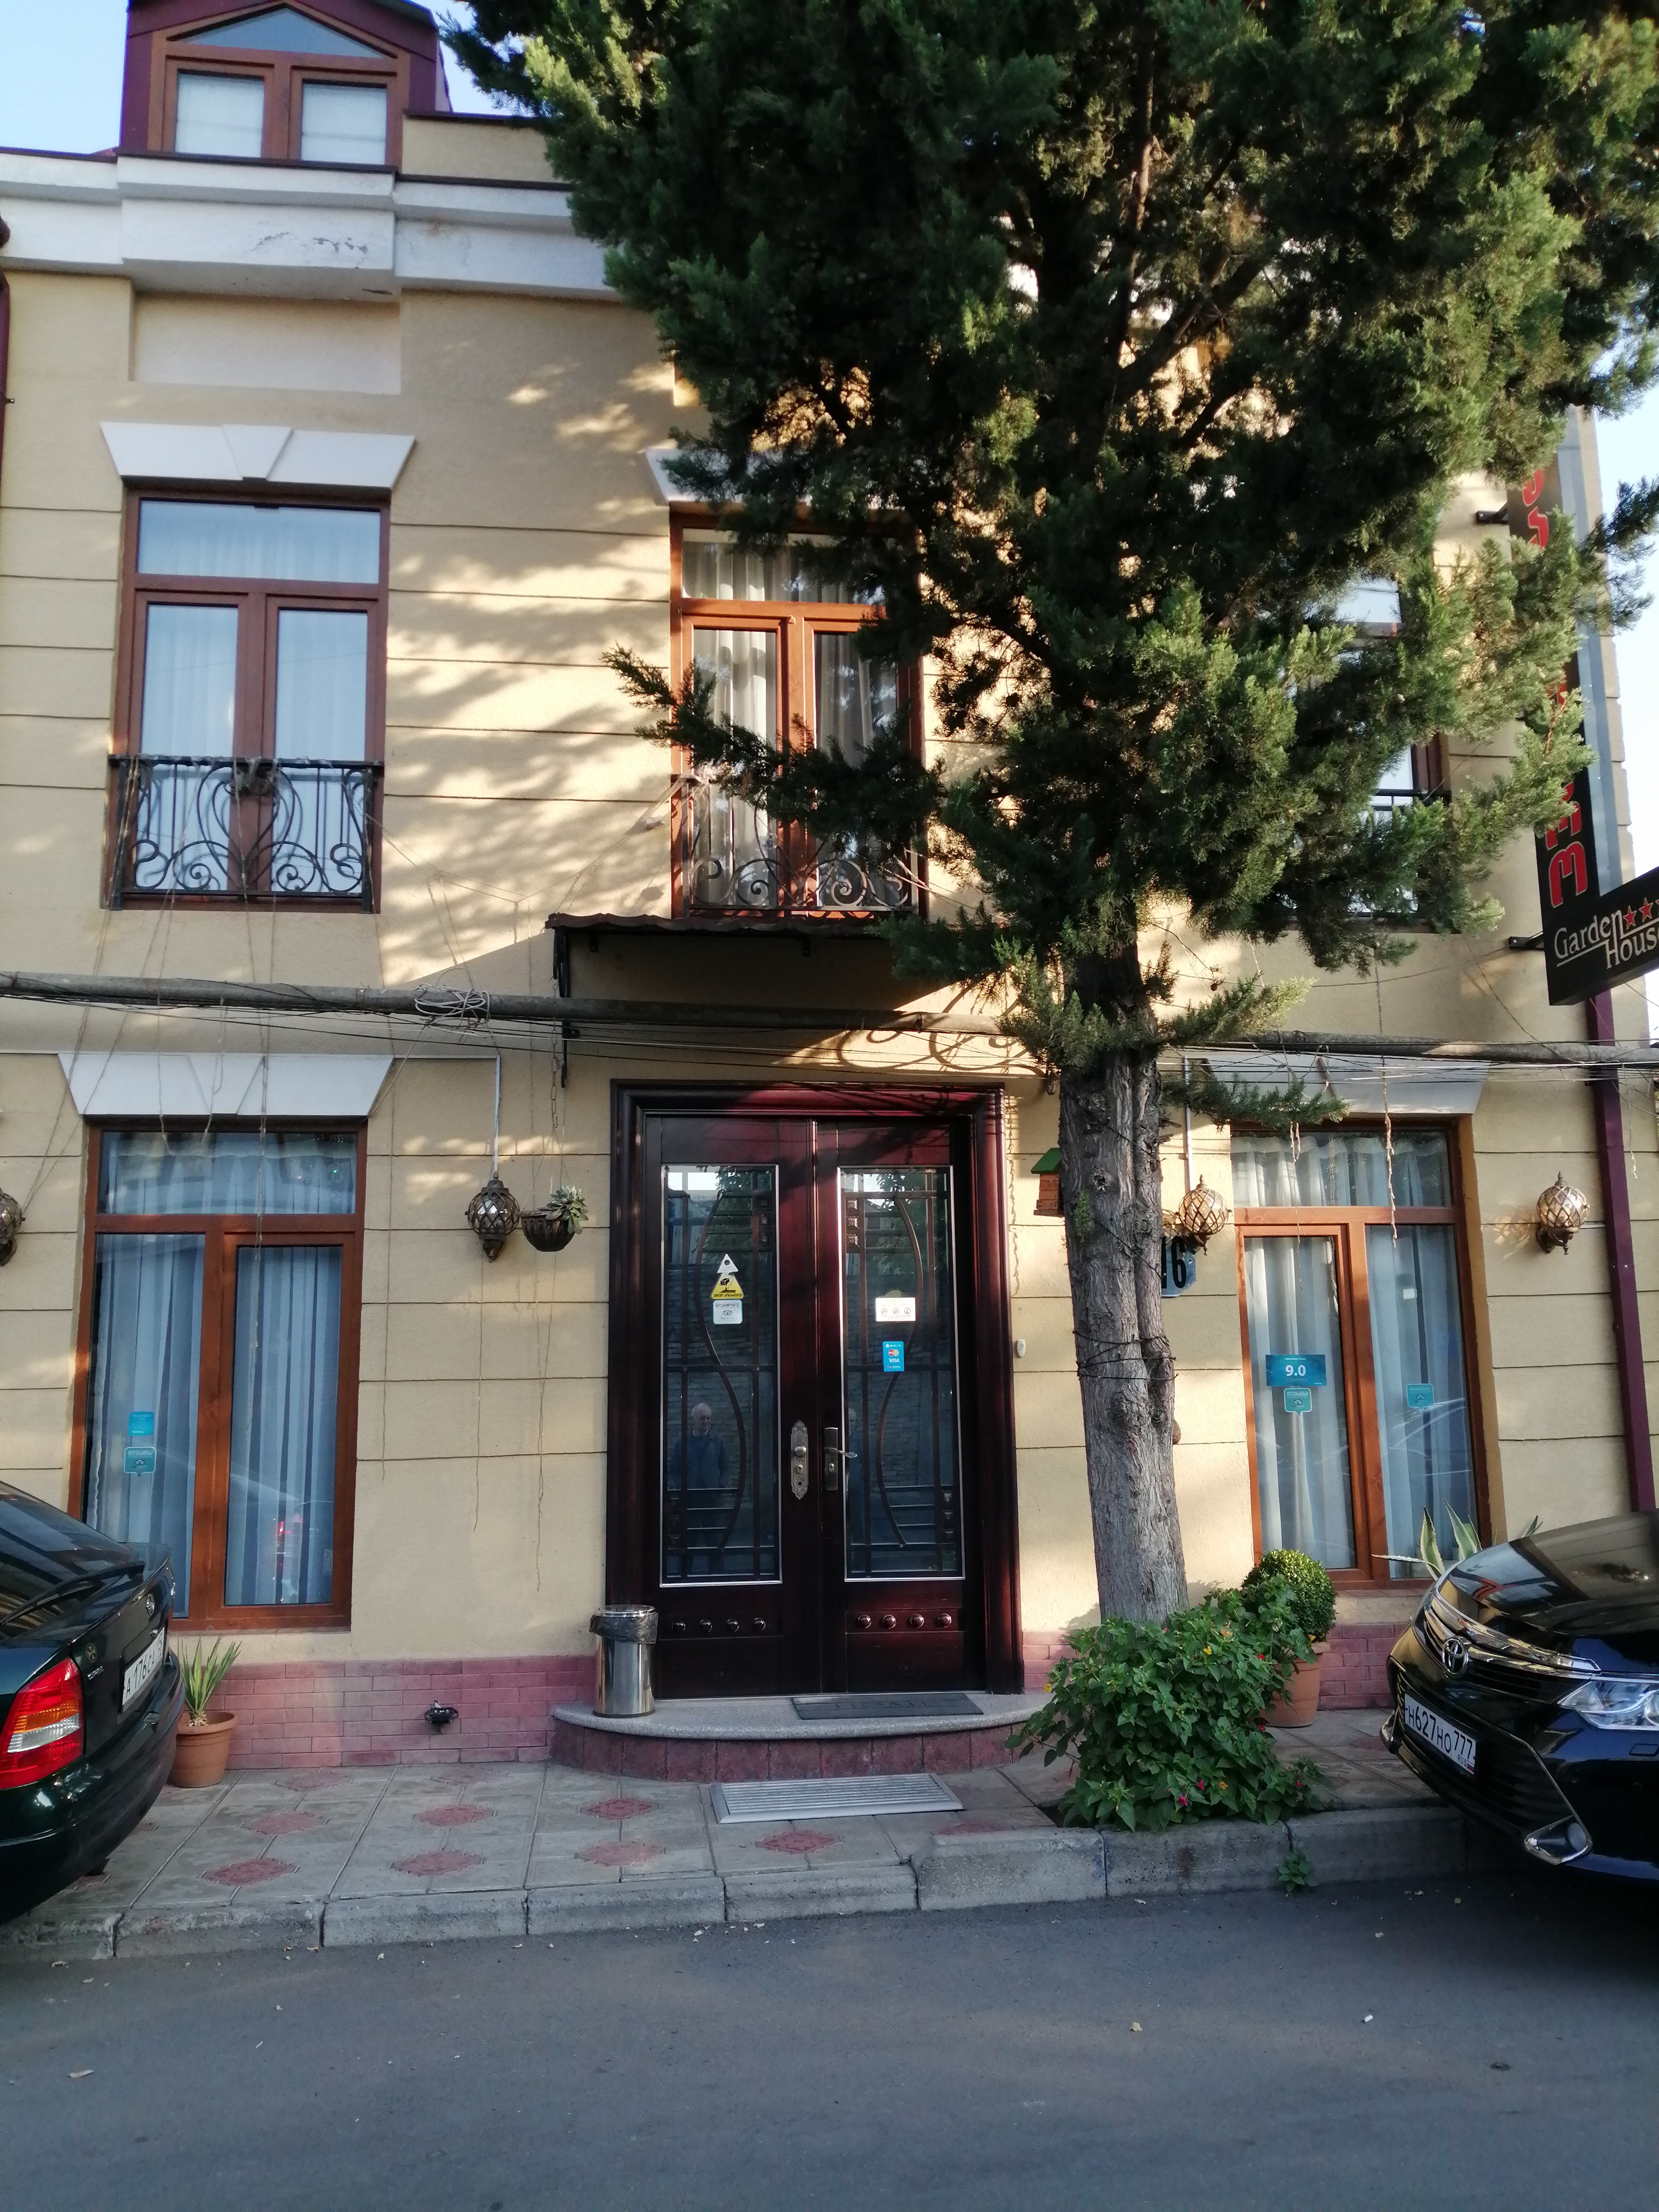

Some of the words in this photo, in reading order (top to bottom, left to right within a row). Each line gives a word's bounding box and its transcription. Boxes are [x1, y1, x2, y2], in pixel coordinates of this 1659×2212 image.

[1554, 910, 1624, 959] Garden
[1605, 927, 1659, 969] Hous
[1285, 1364, 1306, 1377] 9.0
[1457, 1754, 1467, 1766] RUS
